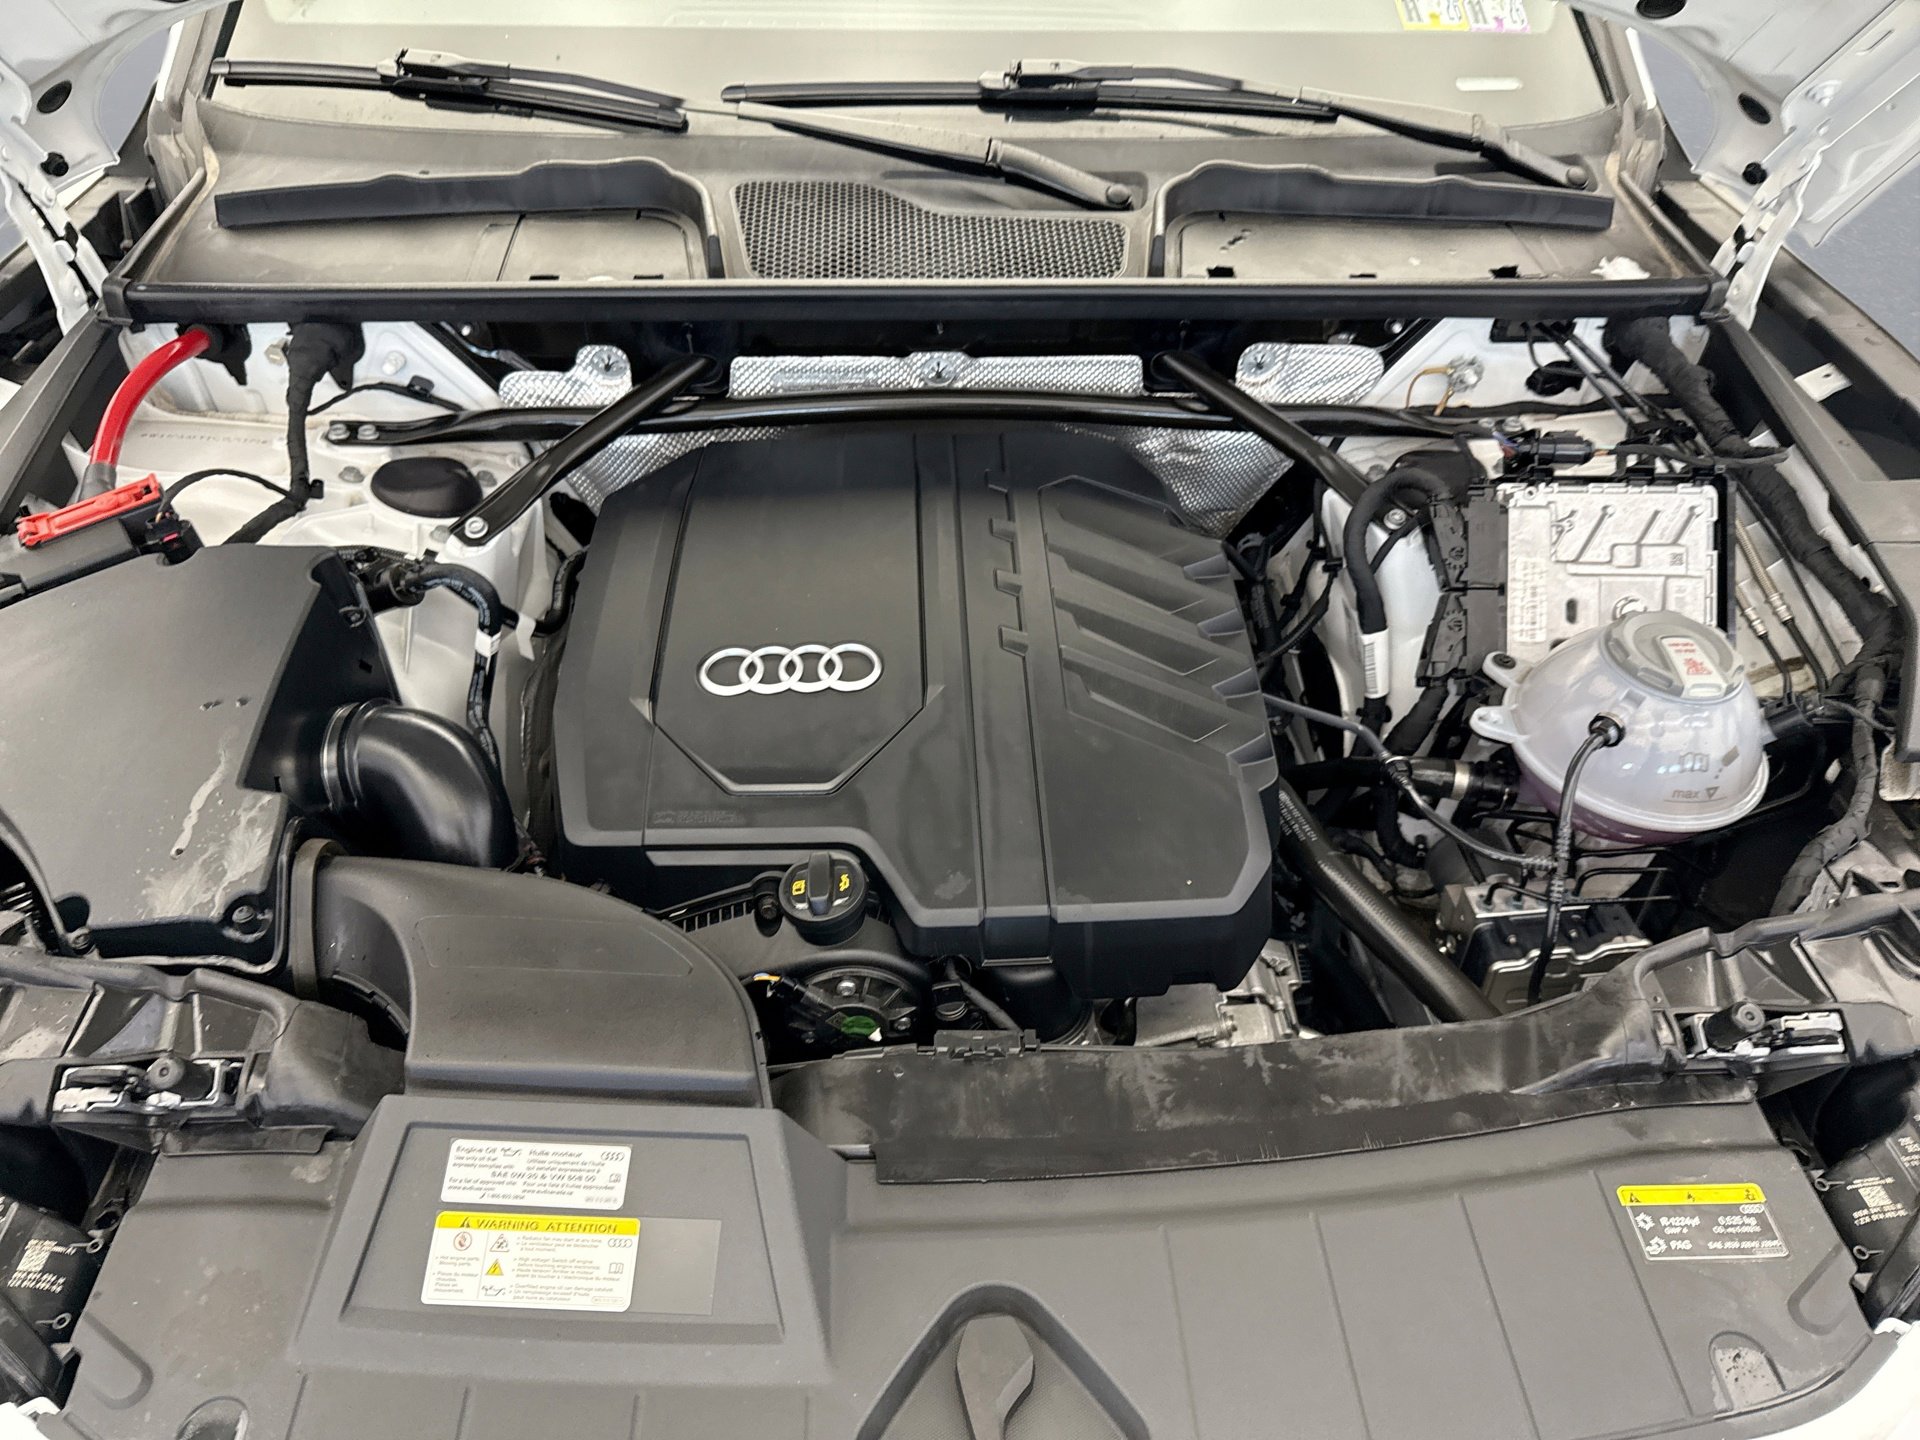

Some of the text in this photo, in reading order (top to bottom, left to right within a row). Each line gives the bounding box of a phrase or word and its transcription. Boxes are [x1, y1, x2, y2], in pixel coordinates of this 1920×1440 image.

[1672, 789, 1700, 799] max
[477, 1218, 618, 1234] WARNING ATTENTION
